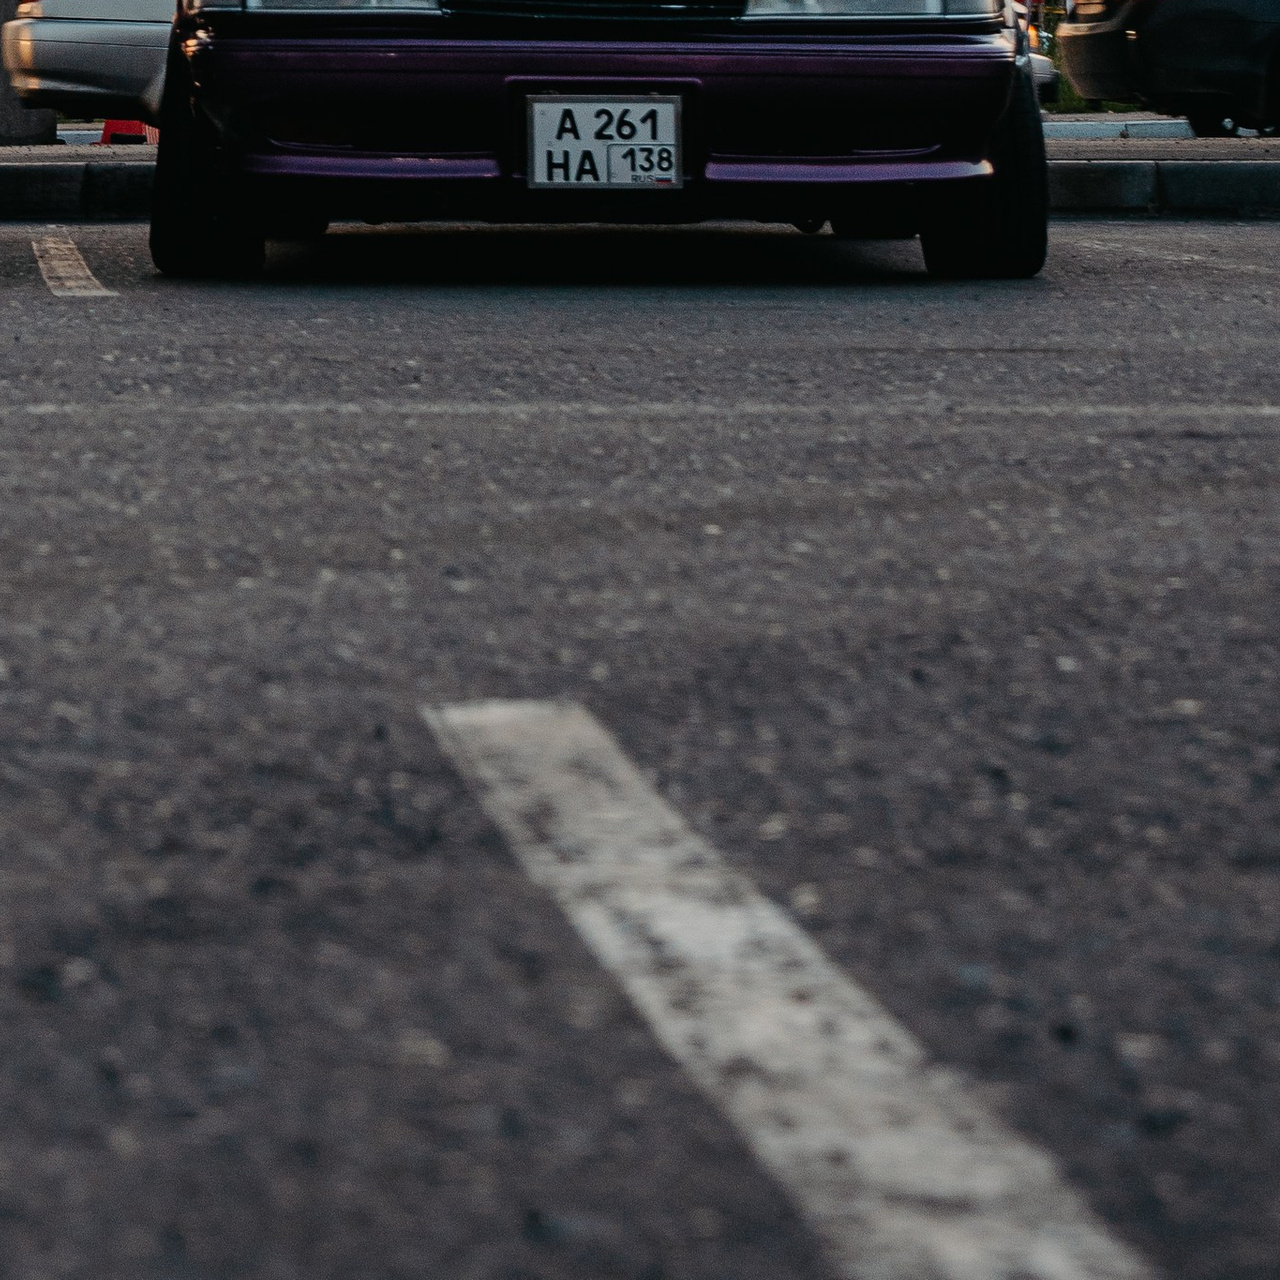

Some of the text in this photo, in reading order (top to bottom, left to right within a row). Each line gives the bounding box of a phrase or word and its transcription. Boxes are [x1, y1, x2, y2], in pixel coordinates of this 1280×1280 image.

[593, 107, 659, 141] 261
[621, 147, 674, 172] 138
[631, 174, 655, 183] RUS
